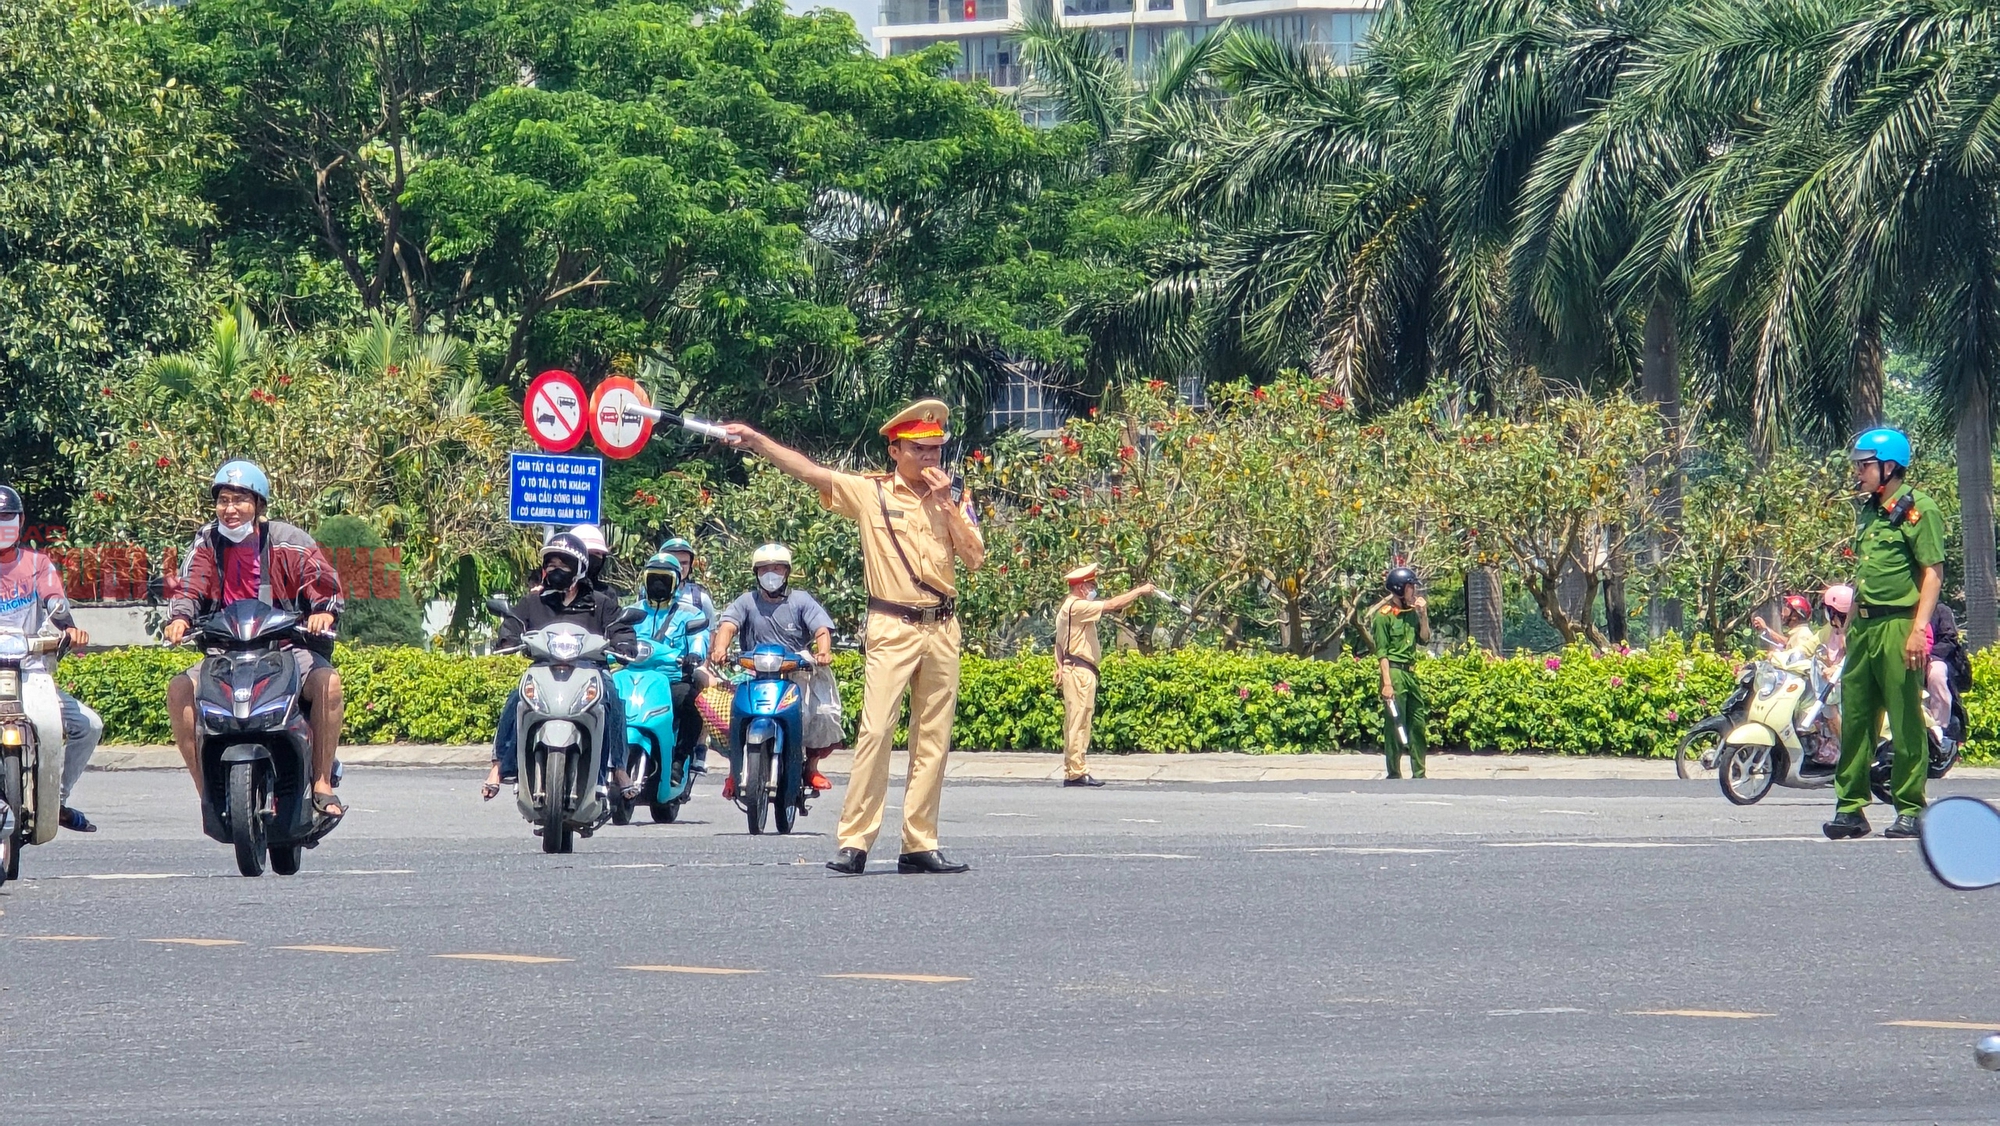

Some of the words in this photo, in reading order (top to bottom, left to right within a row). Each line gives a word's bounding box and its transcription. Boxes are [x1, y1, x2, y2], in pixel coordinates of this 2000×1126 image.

[556, 462, 570, 474] CÁC
[571, 464, 585, 476] LOẠI
[587, 466, 597, 476] XE
[528, 476, 537, 488] TÔ
[559, 478, 567, 490] TÔ
[568, 479, 591, 491] KHÁCH
[523, 491, 537, 503] QUA
[553, 493, 571, 504] SÔNG
[572, 493, 586, 505] HÀN
[530, 506, 556, 518] CAMERA
[557, 507, 574, 519] GIÁM
